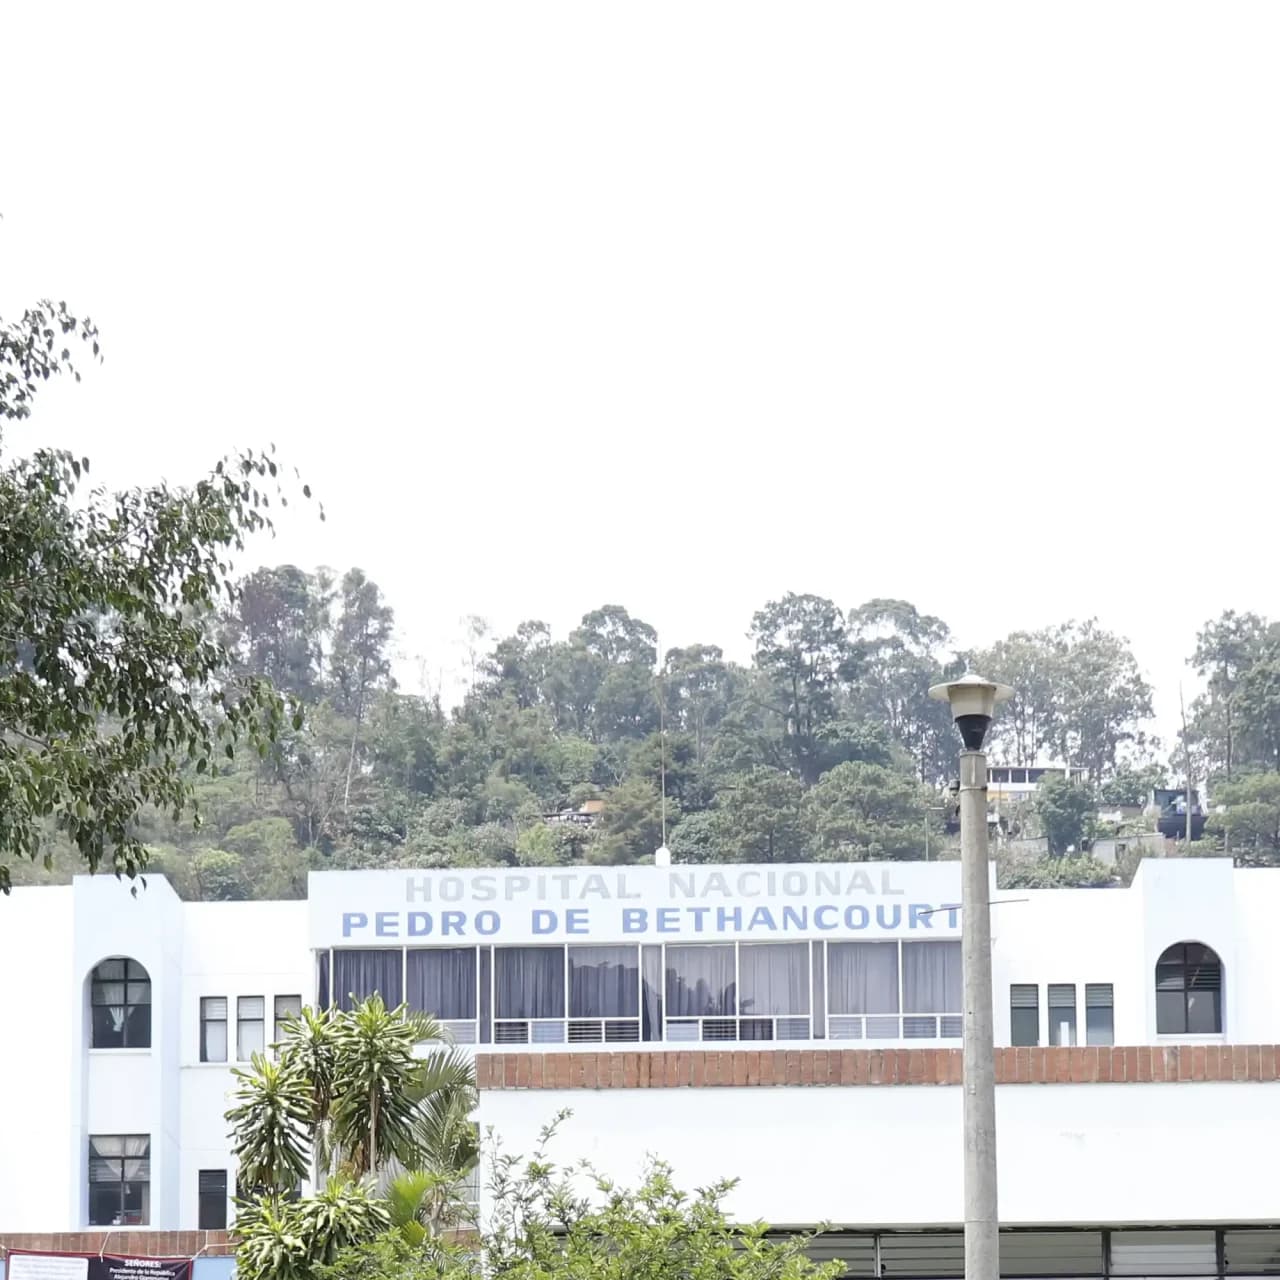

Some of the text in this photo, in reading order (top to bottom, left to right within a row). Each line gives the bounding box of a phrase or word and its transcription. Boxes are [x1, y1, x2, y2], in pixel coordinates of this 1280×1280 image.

[405, 868, 904, 902] HOSPITAL NACIONAL
[341, 903, 962, 937] PEDRO DE BETHANCOURT
